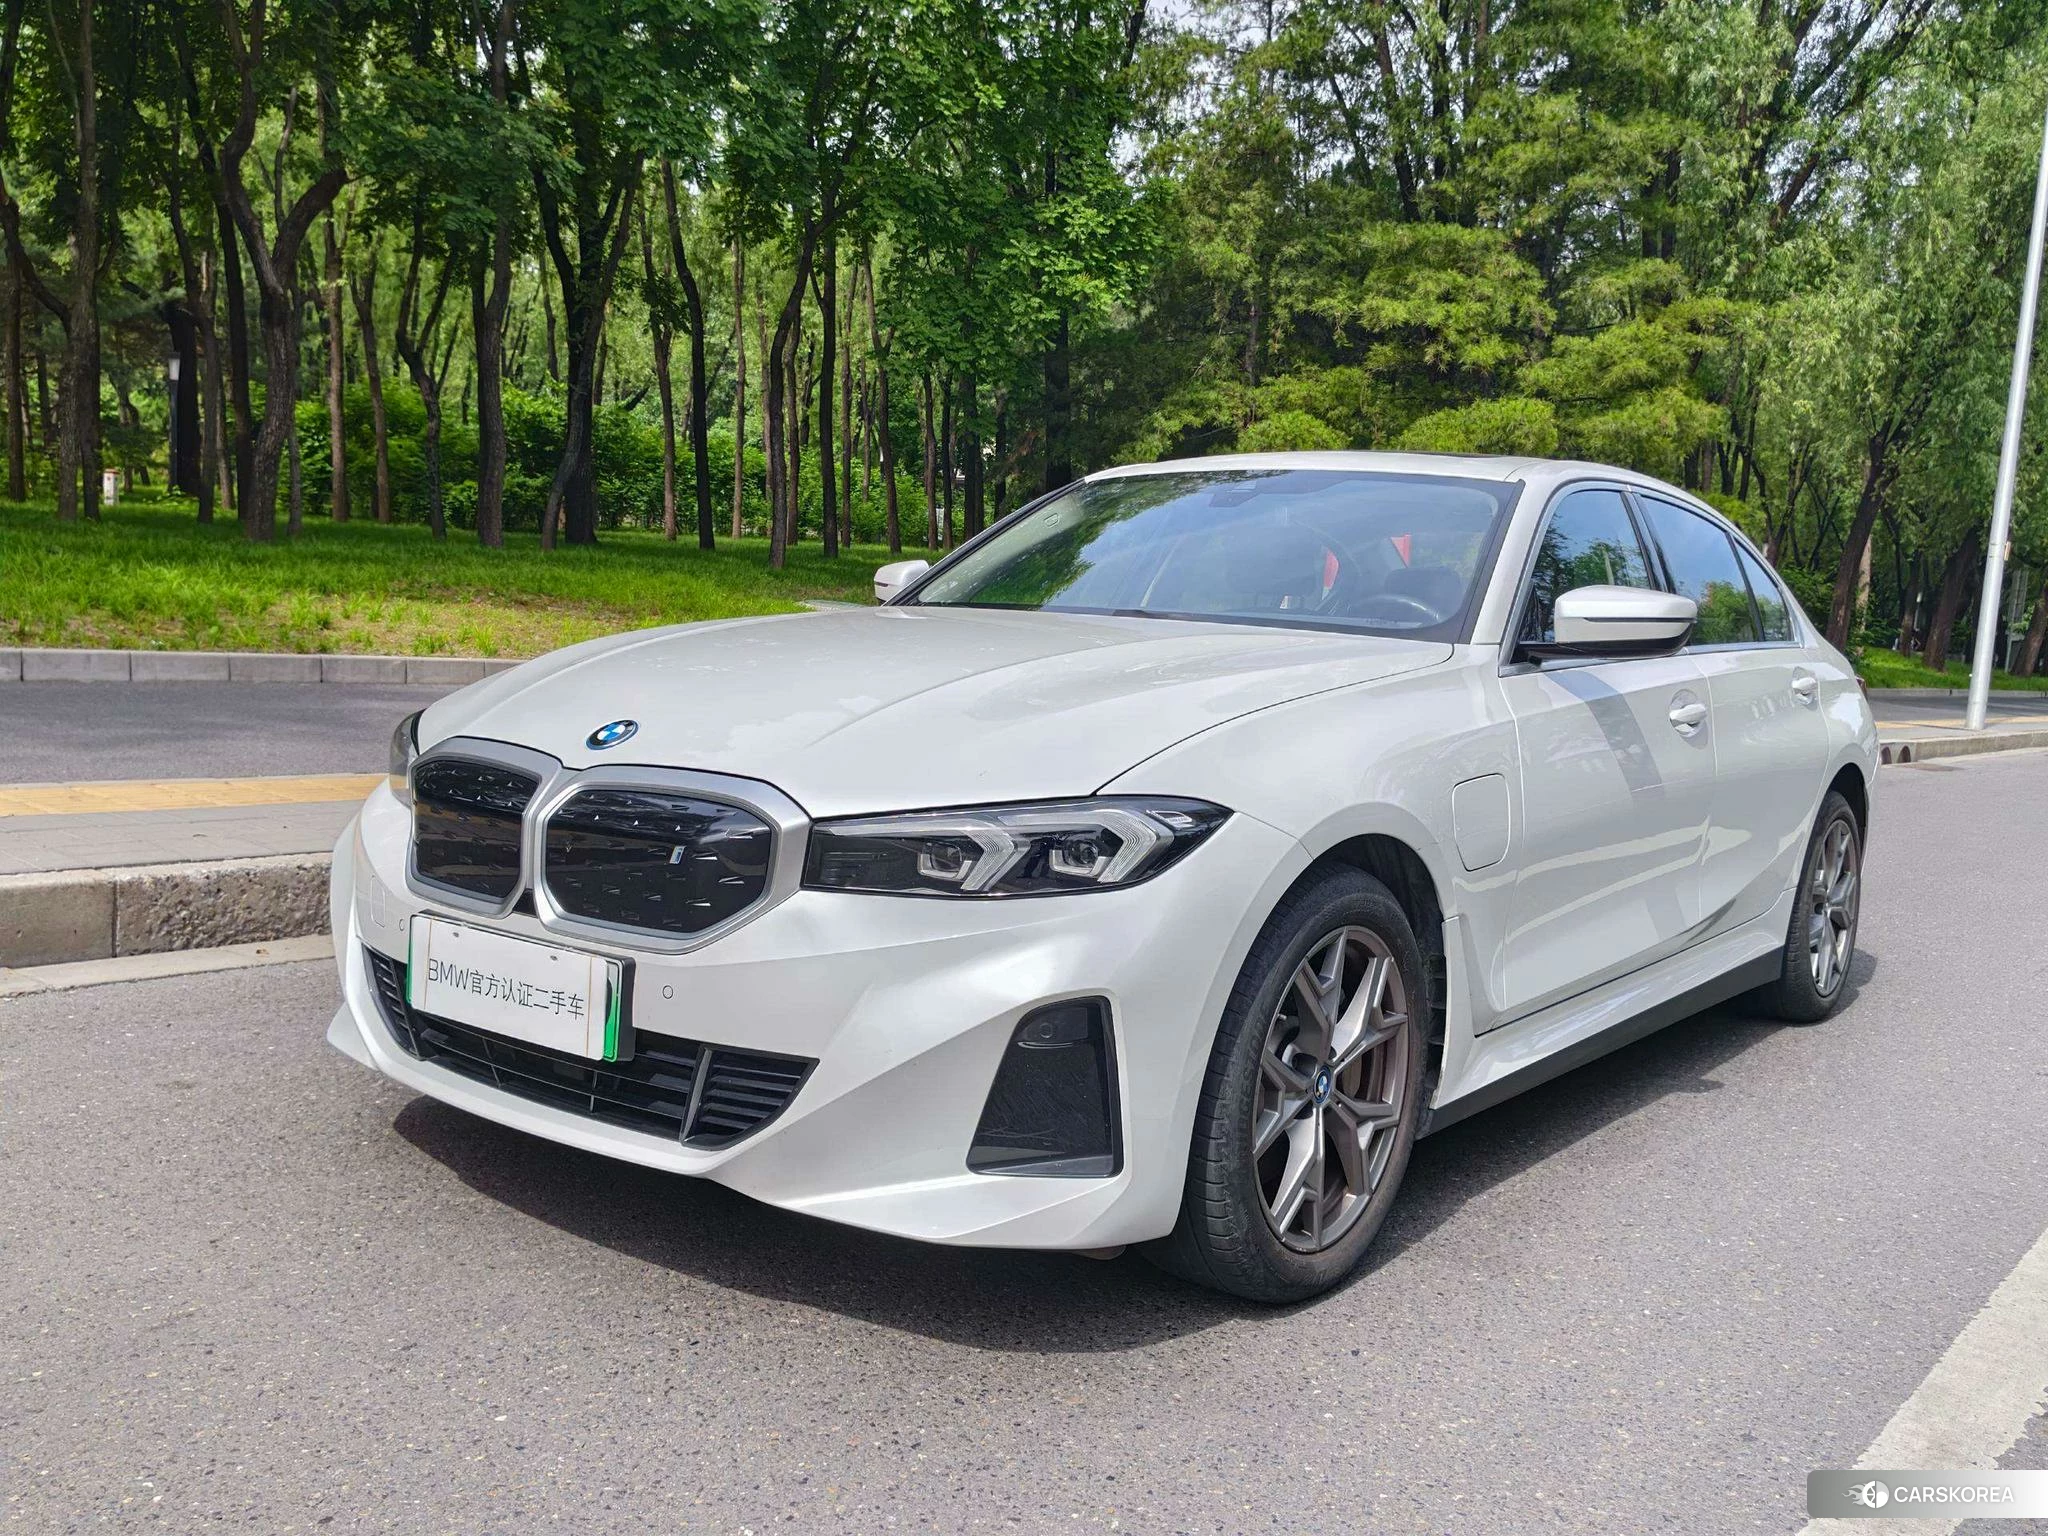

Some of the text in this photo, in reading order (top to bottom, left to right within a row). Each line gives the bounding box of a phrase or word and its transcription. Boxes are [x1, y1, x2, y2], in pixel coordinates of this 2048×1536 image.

[428, 957, 584, 1019] BMW官方认证二手车
